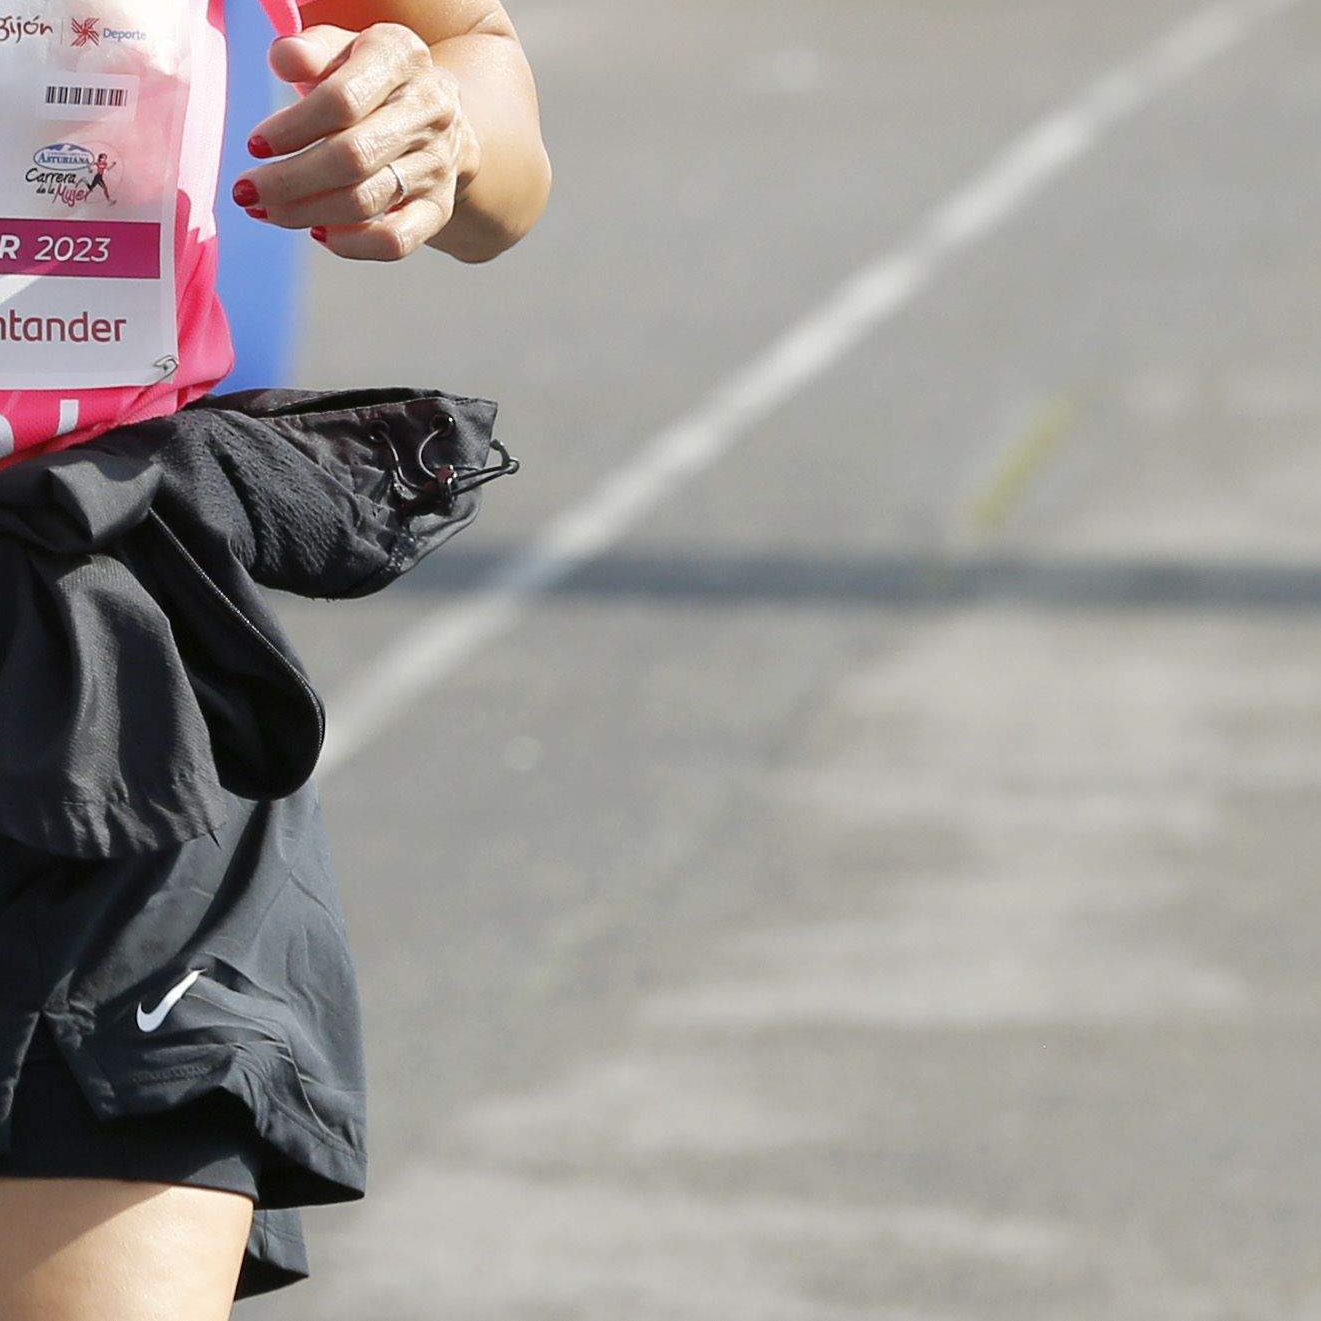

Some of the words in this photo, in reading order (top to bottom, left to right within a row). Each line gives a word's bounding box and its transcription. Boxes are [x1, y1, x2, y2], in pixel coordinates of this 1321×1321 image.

[102, 27, 147, 42] Deporte
[38, 152, 90, 166] ASTURIANA
[25, 167, 77, 185] Carrera
[51, 182, 91, 208] Mujer
[33, 235, 111, 263] 2023
